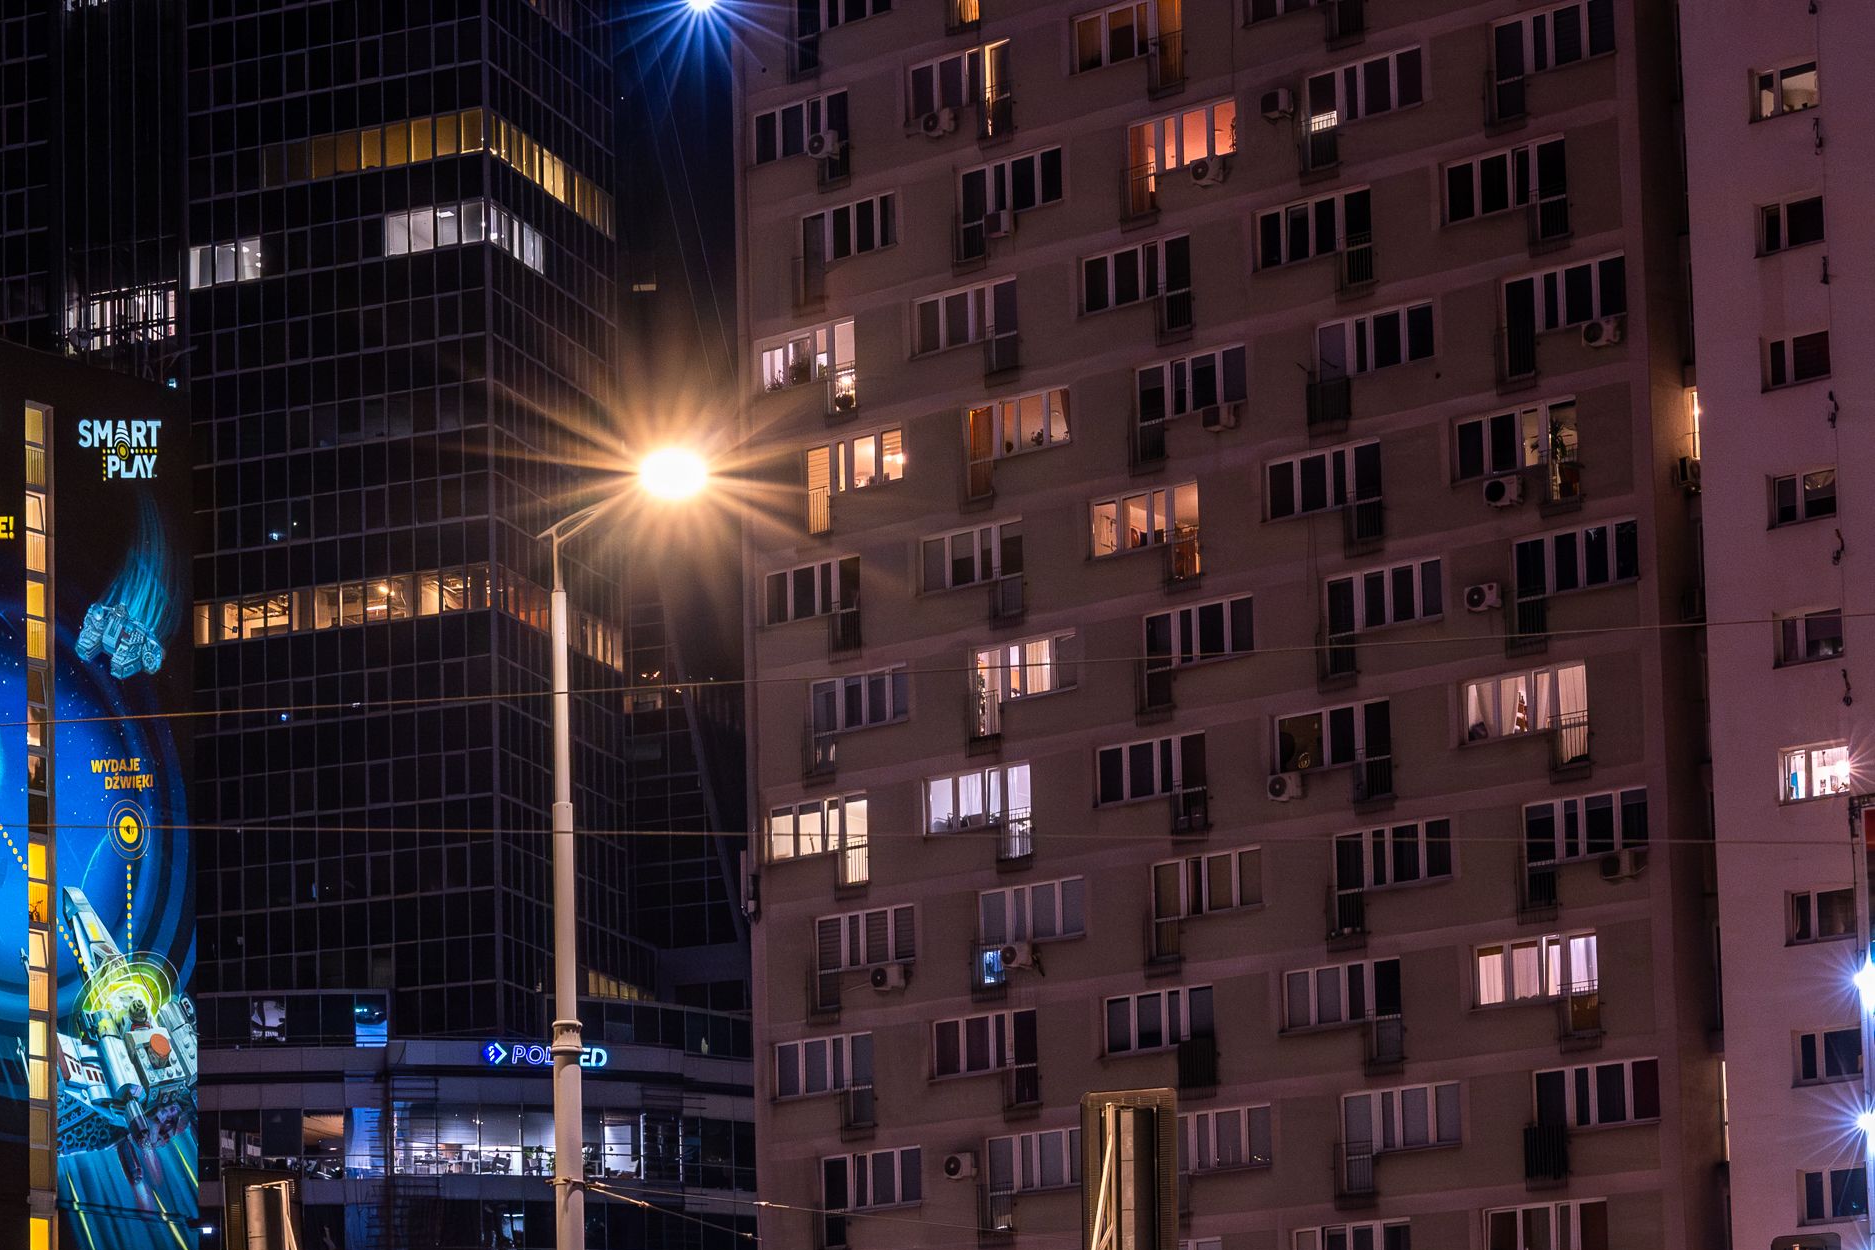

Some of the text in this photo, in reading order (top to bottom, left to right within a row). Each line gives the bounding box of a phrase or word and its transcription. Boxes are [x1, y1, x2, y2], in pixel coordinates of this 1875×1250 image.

[78, 419, 162, 448] SMART
[108, 453, 156, 479] PLAY
[91, 757, 141, 774] WYDAJE
[104, 773, 154, 791] DŹWIĘKI
[511, 1044, 608, 1067] POLED
